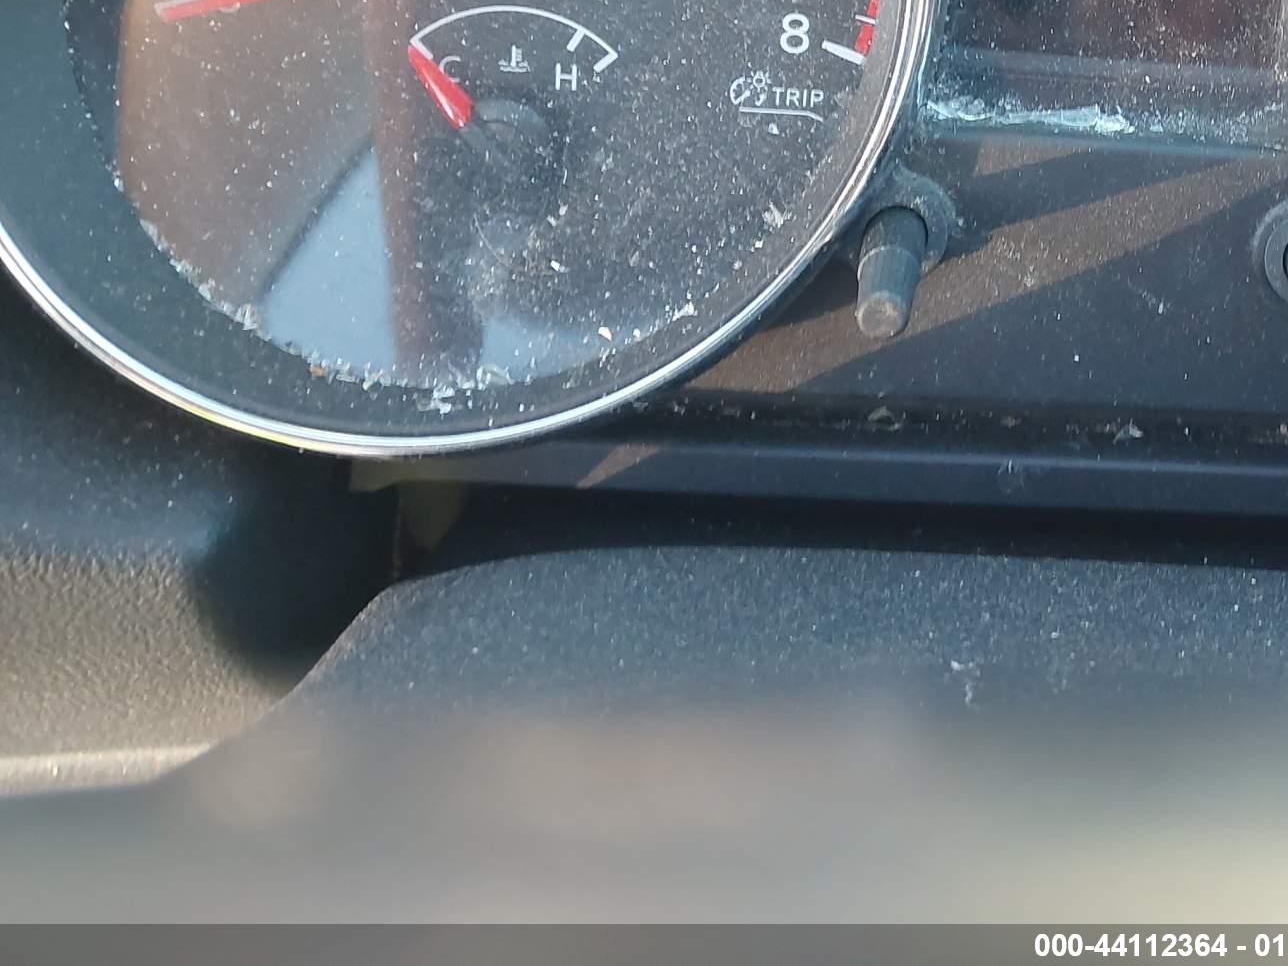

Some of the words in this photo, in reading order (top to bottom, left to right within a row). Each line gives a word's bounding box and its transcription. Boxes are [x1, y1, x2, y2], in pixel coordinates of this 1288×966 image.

[780, 12, 810, 54] 8
[555, 62, 577, 91] H
[772, 87, 825, 109] TRIP
